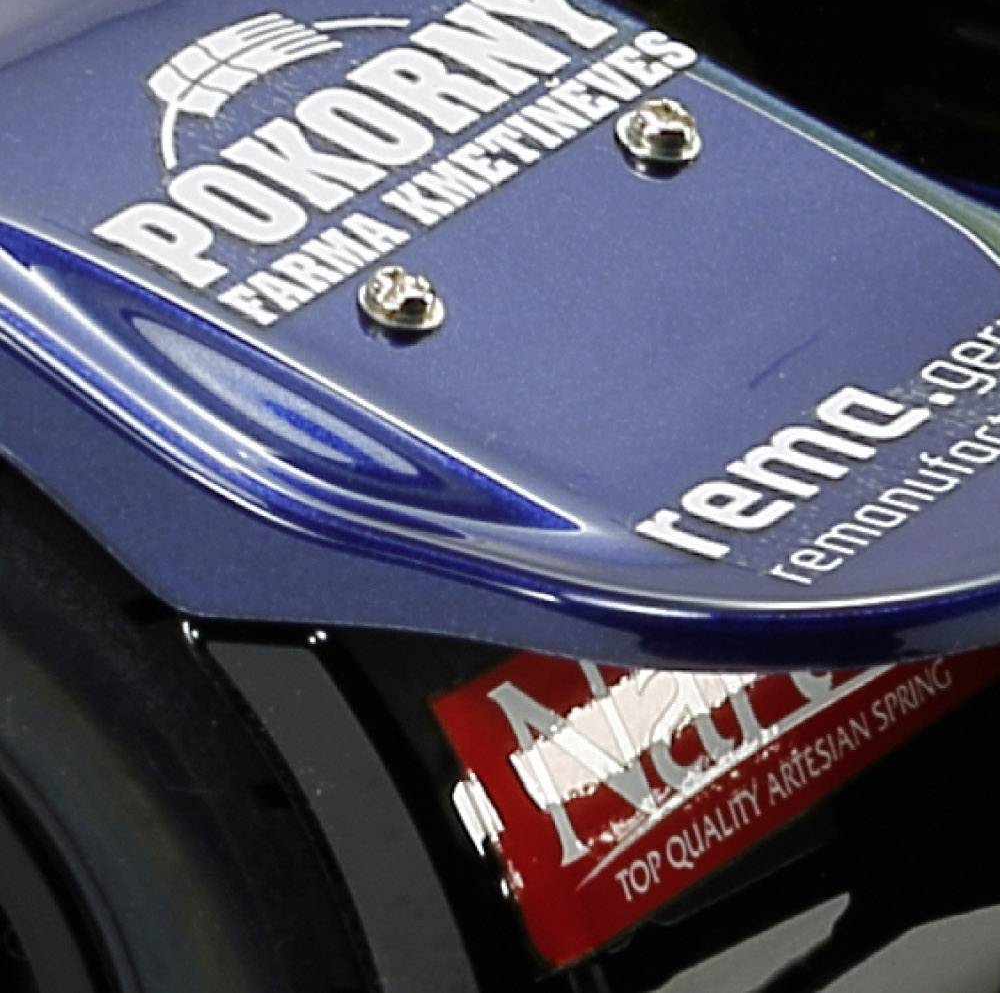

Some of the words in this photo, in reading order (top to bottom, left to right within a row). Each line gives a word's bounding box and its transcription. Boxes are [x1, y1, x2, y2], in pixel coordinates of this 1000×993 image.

[217, 213, 411, 326] FARMA
[614, 857, 662, 902] TOP
[665, 786, 764, 872] QUALITY
[766, 716, 871, 808] ARTESIAN
[873, 659, 953, 734] SPRING
